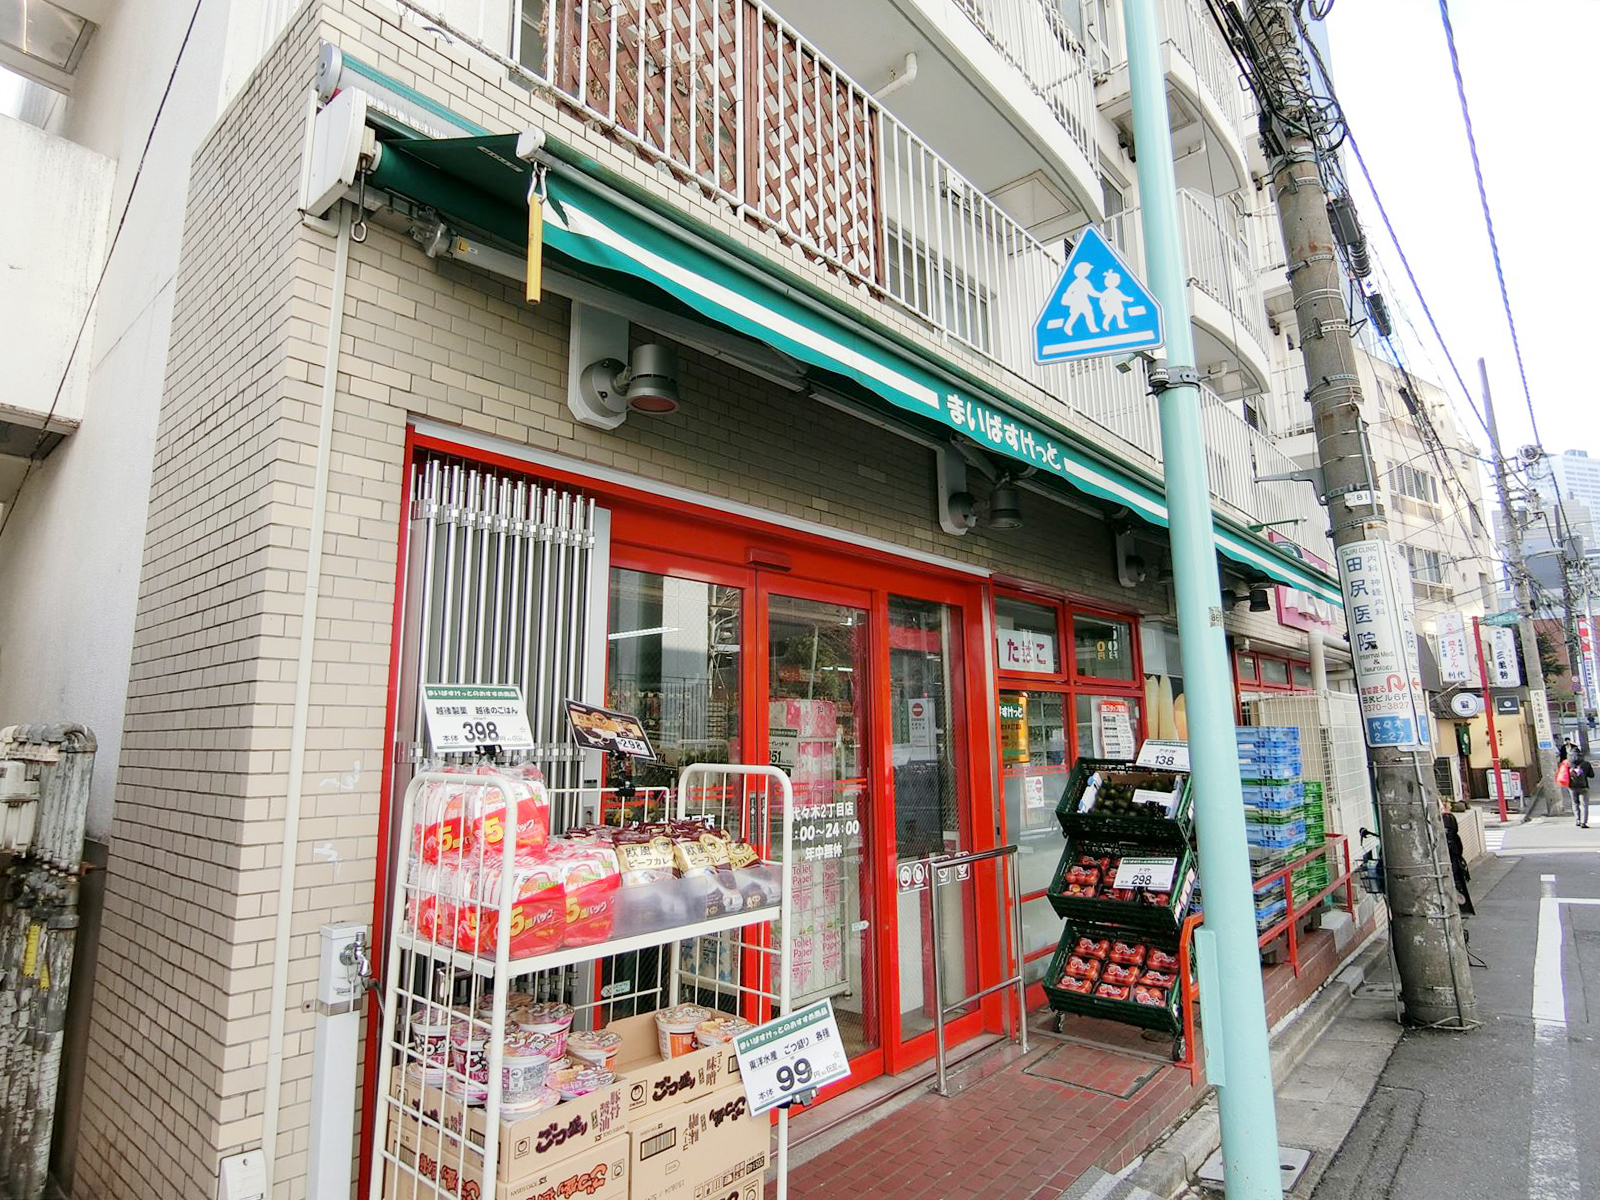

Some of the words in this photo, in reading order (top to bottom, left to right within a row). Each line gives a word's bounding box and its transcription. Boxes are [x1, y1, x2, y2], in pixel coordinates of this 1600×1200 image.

[946, 393, 1062, 471] まいばすけっと
[1346, 556, 1379, 652] 田尻医院
[462, 721, 500, 744] 398
[1372, 719, 1405, 730] 代々木
[620, 738, 643, 751] 298
[1374, 731, 1405, 742] 2-27
[1154, 755, 1175, 766] 138
[804, 842, 843, 862] 年中無休
[1131, 874, 1153, 886] 298
[749, 1050, 778, 1071] 東洋水産
[784, 1037, 810, 1056] ごつ盛り
[815, 1027, 831, 1041] 各種
[652, 1070, 696, 1102] ごつ盛り
[776, 1057, 813, 1092] 99
[535, 1114, 588, 1154] ごつ盛り
